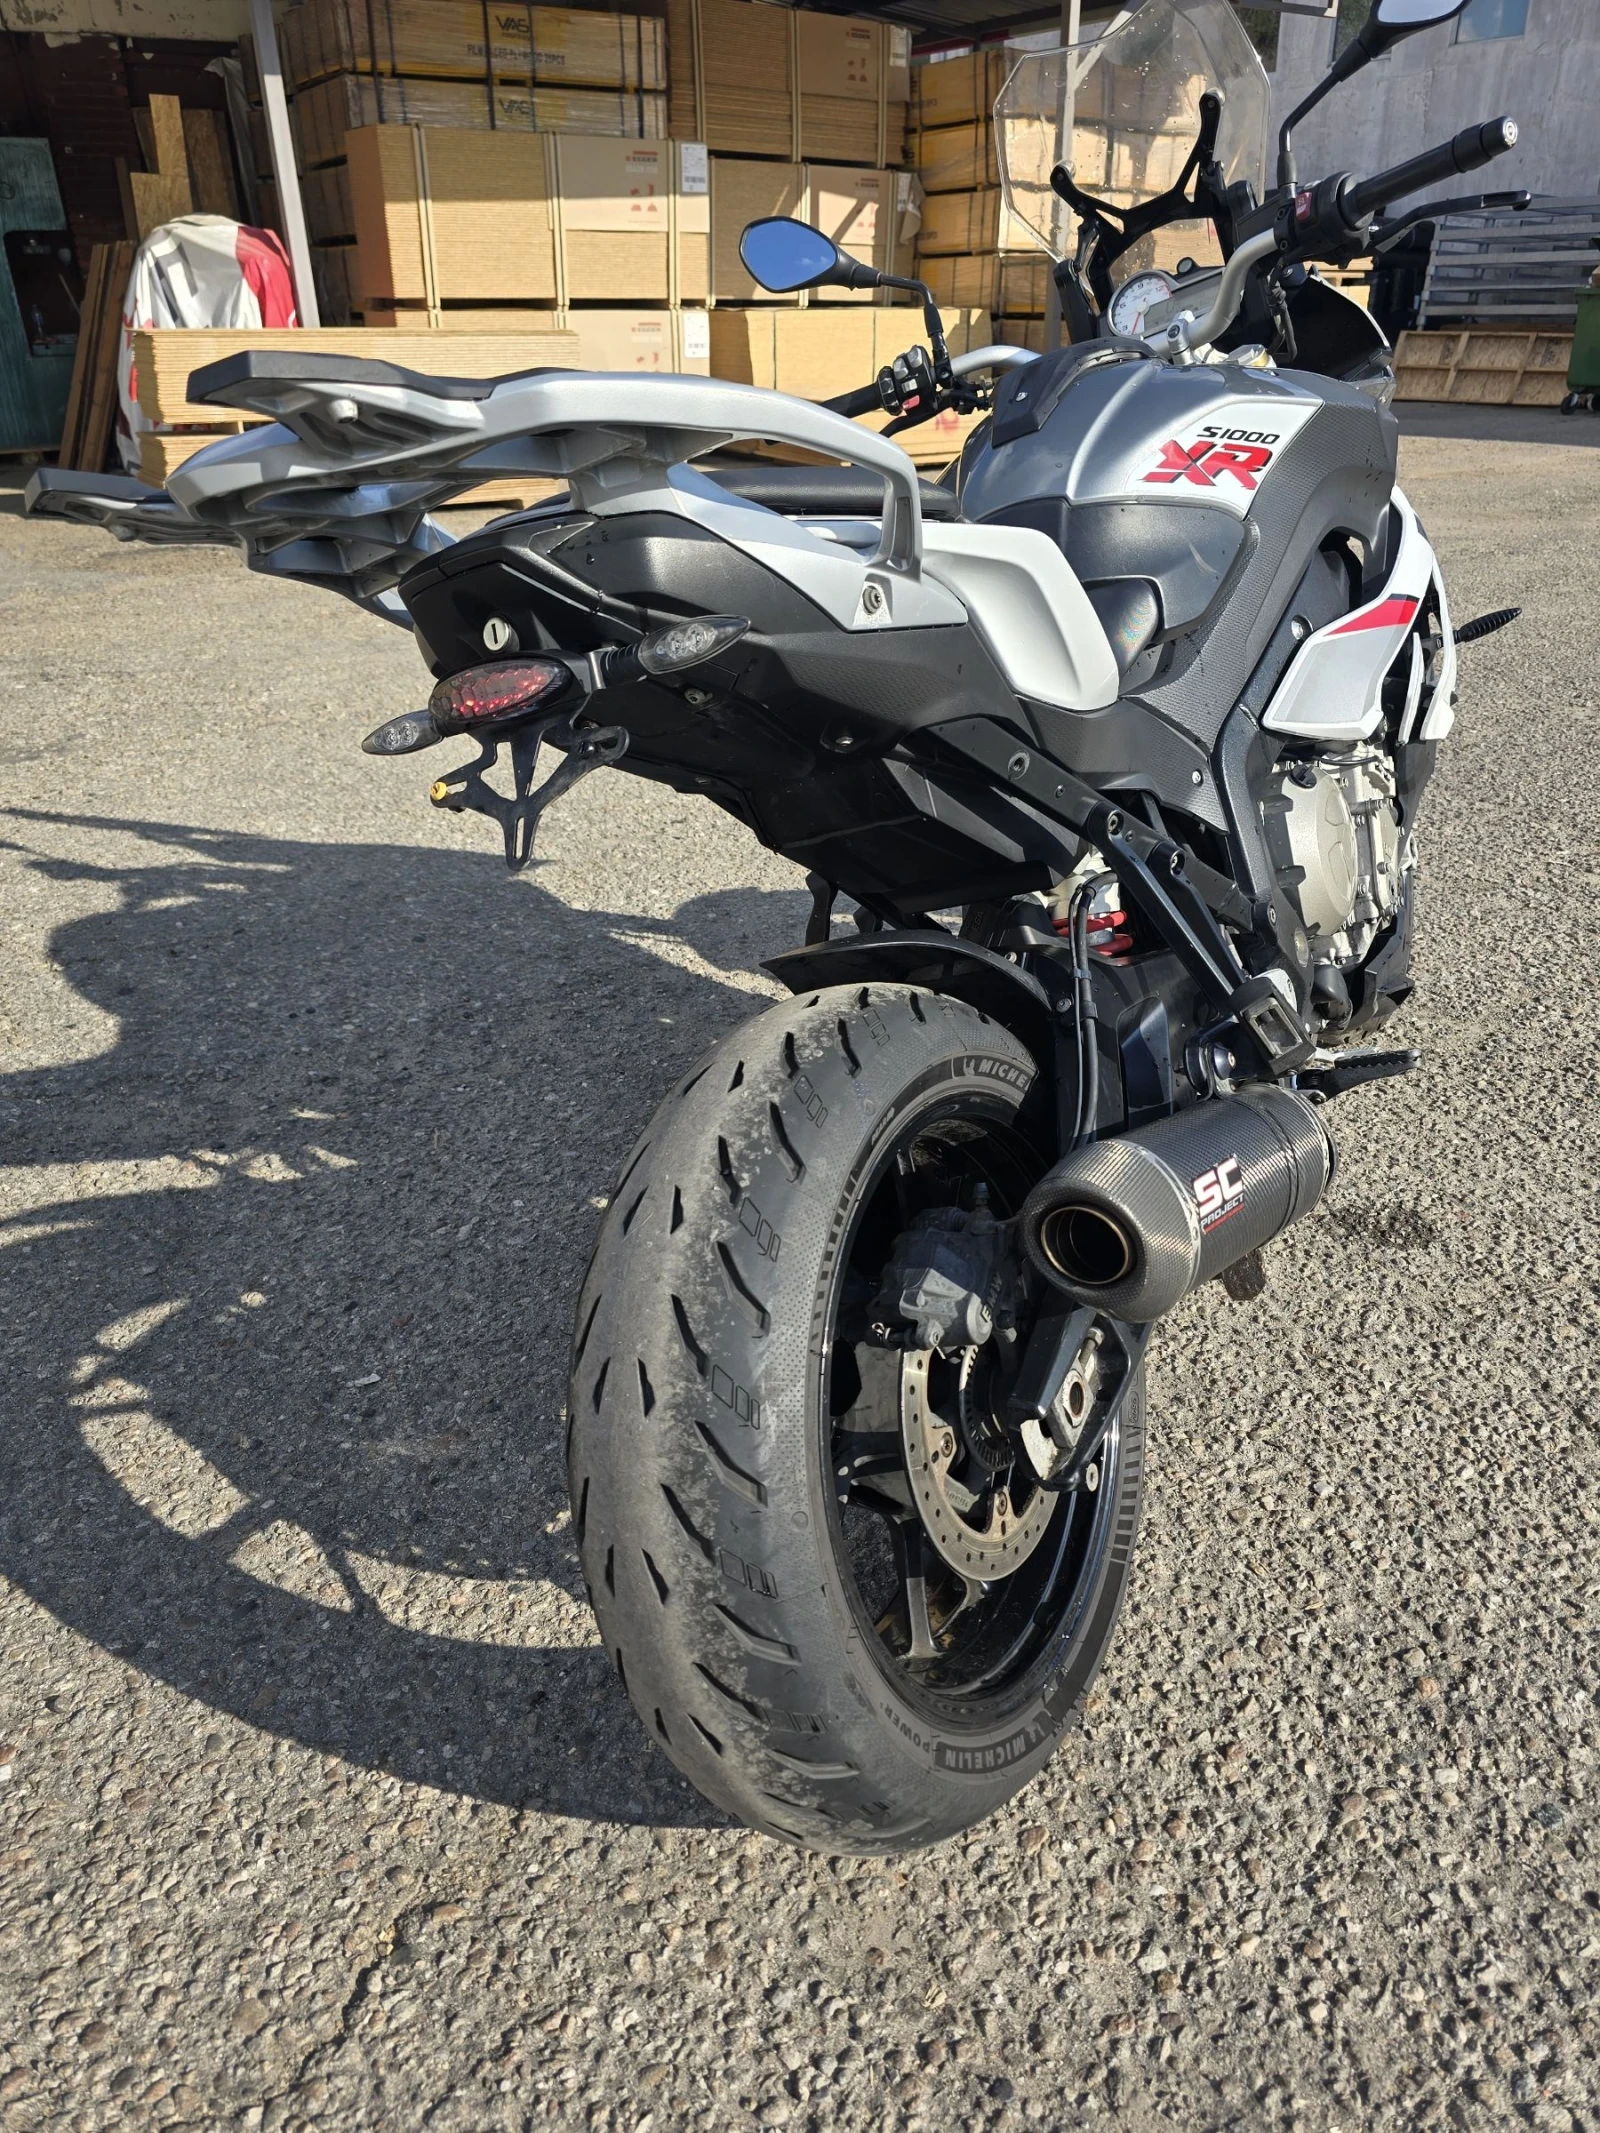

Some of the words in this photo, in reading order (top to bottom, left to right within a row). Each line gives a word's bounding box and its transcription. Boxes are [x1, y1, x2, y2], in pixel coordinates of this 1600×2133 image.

[495, 15, 530, 33] VAS
[1197, 426, 1280, 445] S1000
[1138, 439, 1273, 491] XR
[979, 1058, 1031, 1091] MICHE
[1193, 1157, 1243, 1218] SC
[1200, 1193, 1244, 1228] PROJECT
[884, 1703, 931, 1754] POWER
[945, 1734, 1027, 1770] MICHELIN
